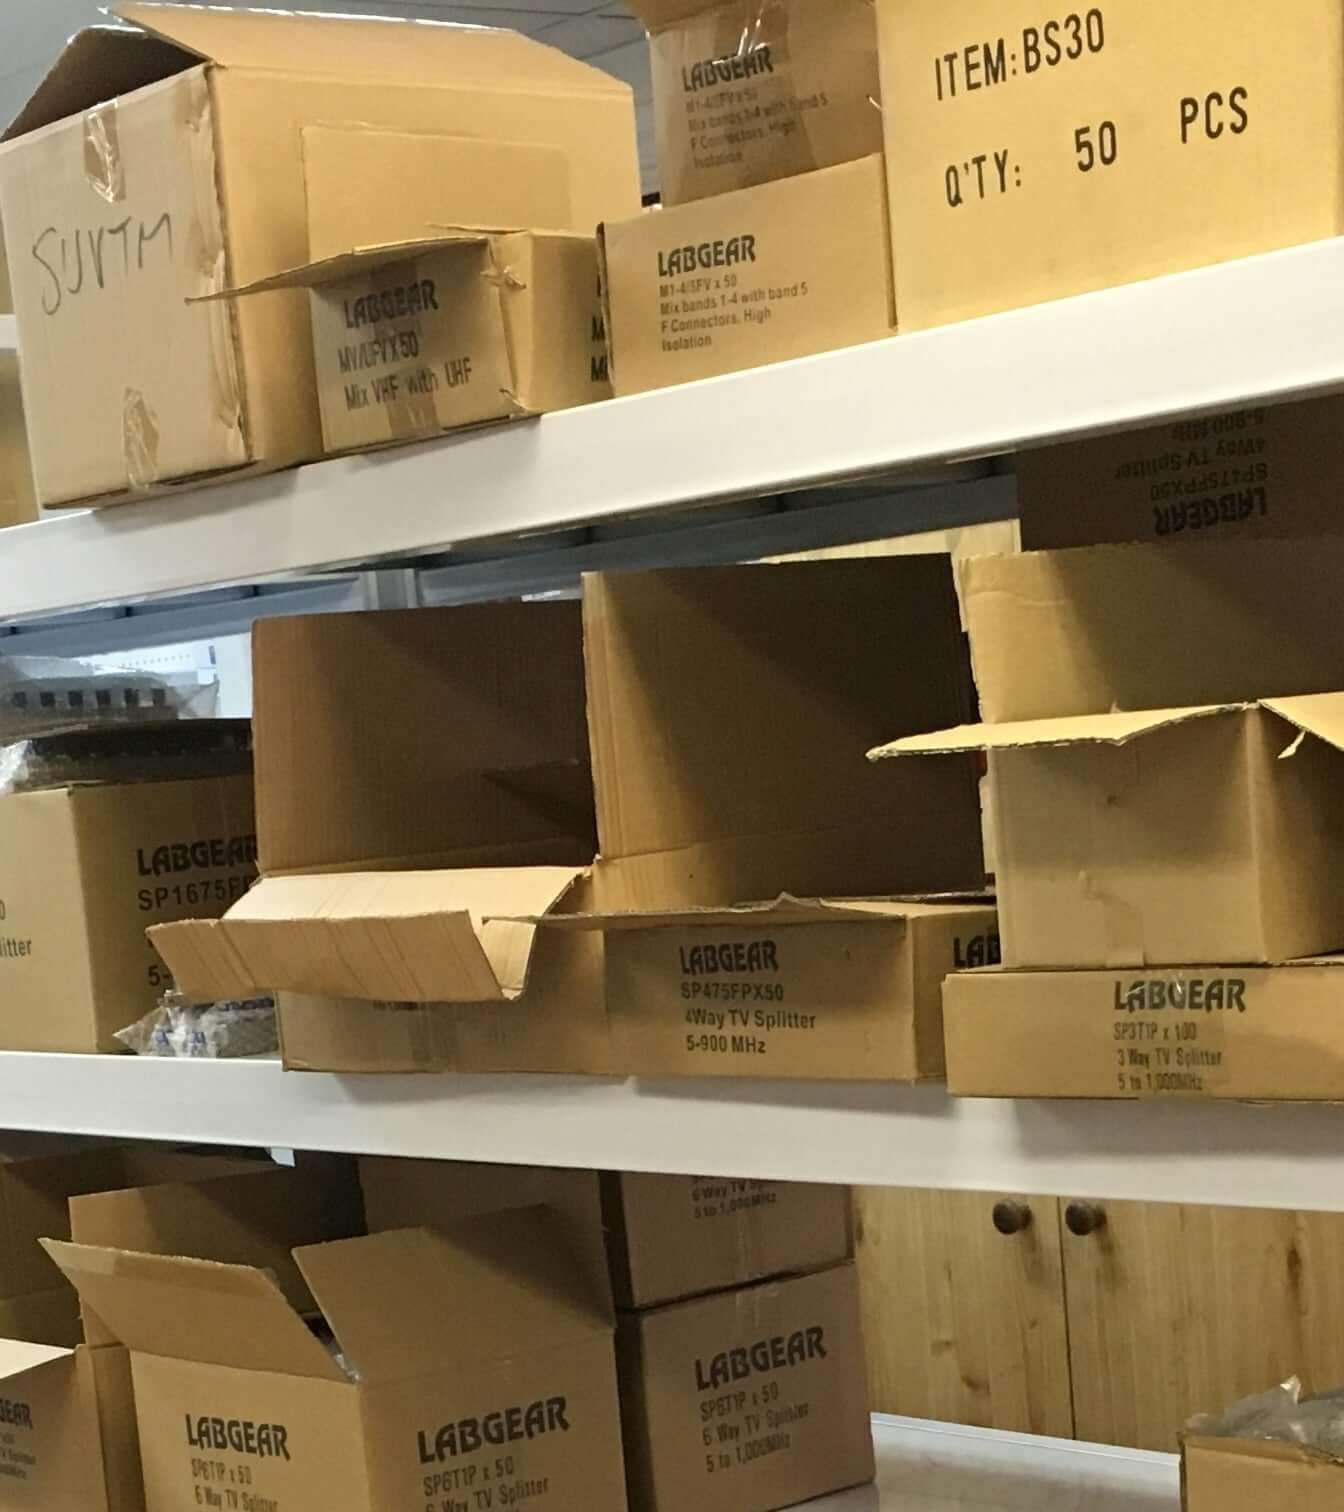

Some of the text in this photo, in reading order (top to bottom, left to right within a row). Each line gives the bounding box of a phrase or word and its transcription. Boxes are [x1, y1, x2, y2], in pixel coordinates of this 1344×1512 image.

[935, 9, 1106, 102] ITEM:BS30
[1075, 87, 1250, 173] 50 PCS
[657, 235, 755, 277] LABGEAR
[344, 279, 439, 328] LABGEAR
[443, 357, 473, 387] UHF
[679, 940, 779, 976] LABGEAR
[681, 981, 784, 1001] SP475FPX50
[1114, 979, 1246, 1013] LABGEAR
[729, 1008, 816, 1032] TV Splitter
[687, 1035, 766, 1054] 5-900 MHz
[1176, 1048, 1222, 1069] Splitter
[695, 1326, 827, 1392] LABGEAR
[185, 1413, 291, 1461] LABGEAR
[417, 1396, 570, 1465] LABGEAR
[745, 1414, 760, 1435] TV
[495, 1456, 514, 1478] 50
[473, 1488, 492, 1508] TV
[499, 1478, 549, 1505] Splitter
